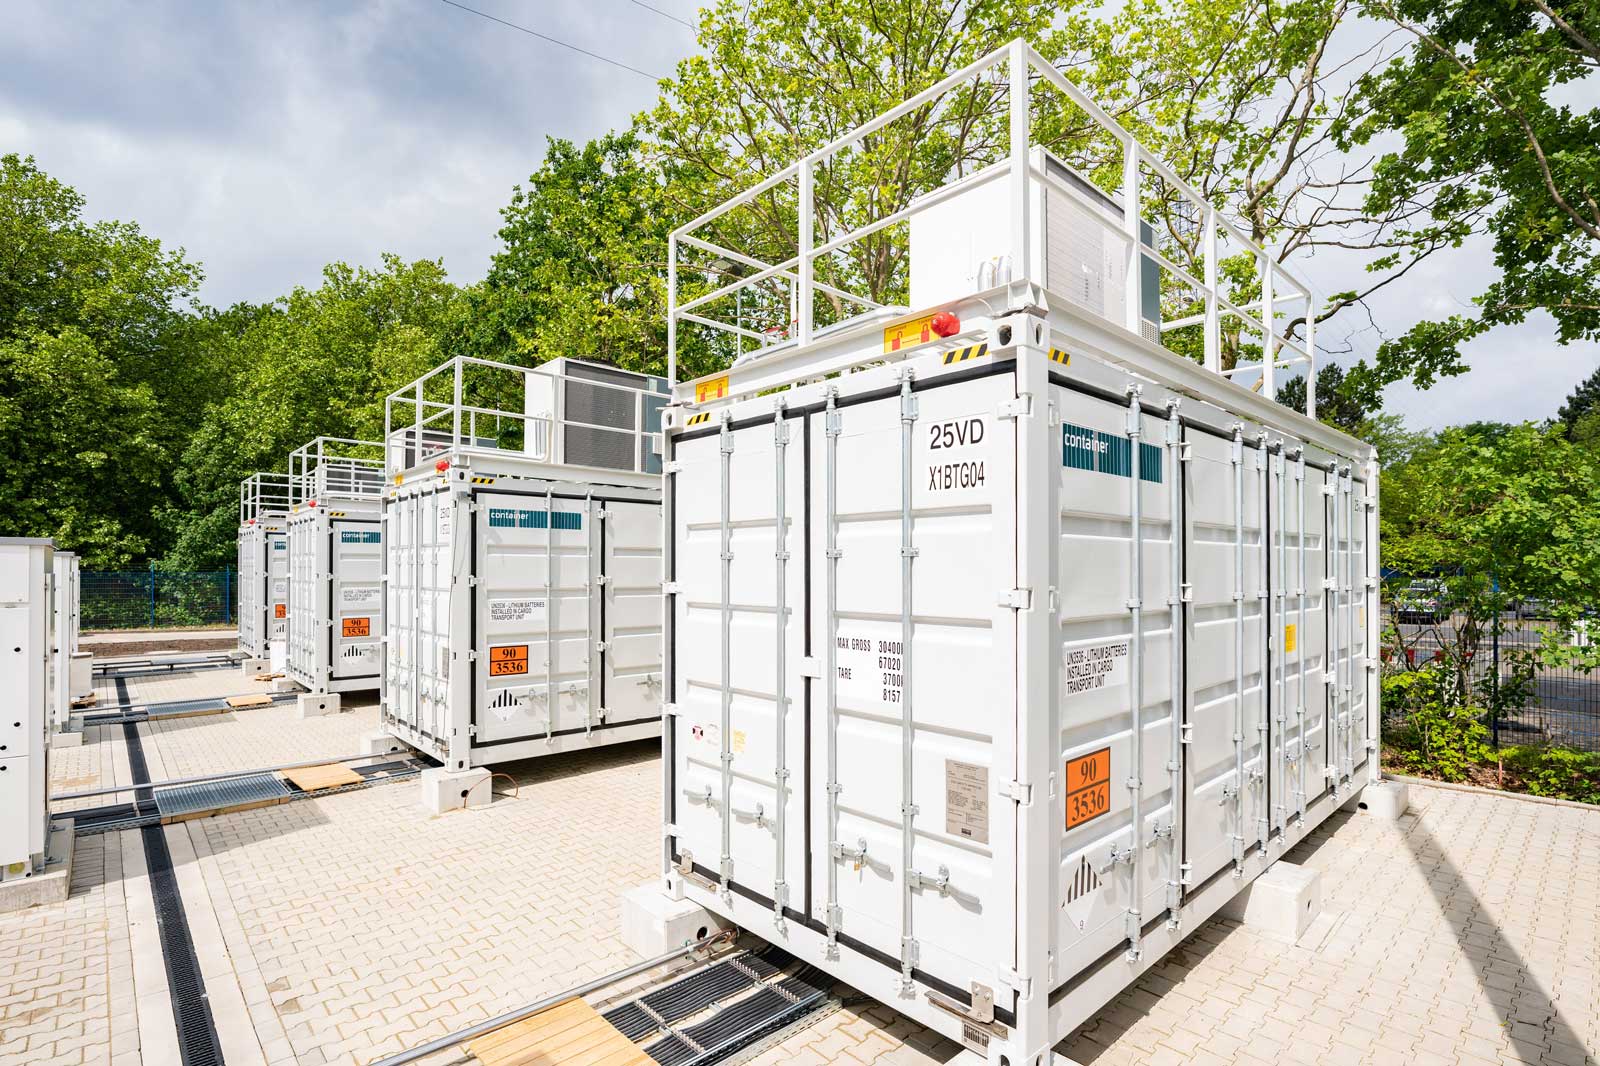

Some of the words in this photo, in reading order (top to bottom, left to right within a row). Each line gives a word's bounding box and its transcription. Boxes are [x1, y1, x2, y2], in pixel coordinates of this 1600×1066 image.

[930, 418, 984, 450] 25VD
[1064, 433, 1109, 454] container
[929, 460, 985, 491] X1BTG04
[490, 512, 529, 520] container
[351, 619, 361, 627] 90
[837, 636, 849, 650] MAX
[852, 638, 871, 652] GROSS
[502, 648, 516, 659] 90
[1087, 647, 1105, 662] LITHIUM
[1105, 644, 1127, 659] BATTERIES
[495, 661, 523, 674] 3536
[879, 656, 901, 671] 67020
[1067, 663, 1091, 680] INSTALLED
[1092, 662, 1097, 675] IN
[1098, 659, 1113, 673] CARGO
[838, 667, 852, 680] TARE
[1067, 676, 1094, 694] TRANSPORT
[1095, 674, 1105, 688] UNIT
[883, 688, 901, 703] 8157
[1080, 757, 1097, 785] 90
[1072, 786, 1105, 822] 3536
